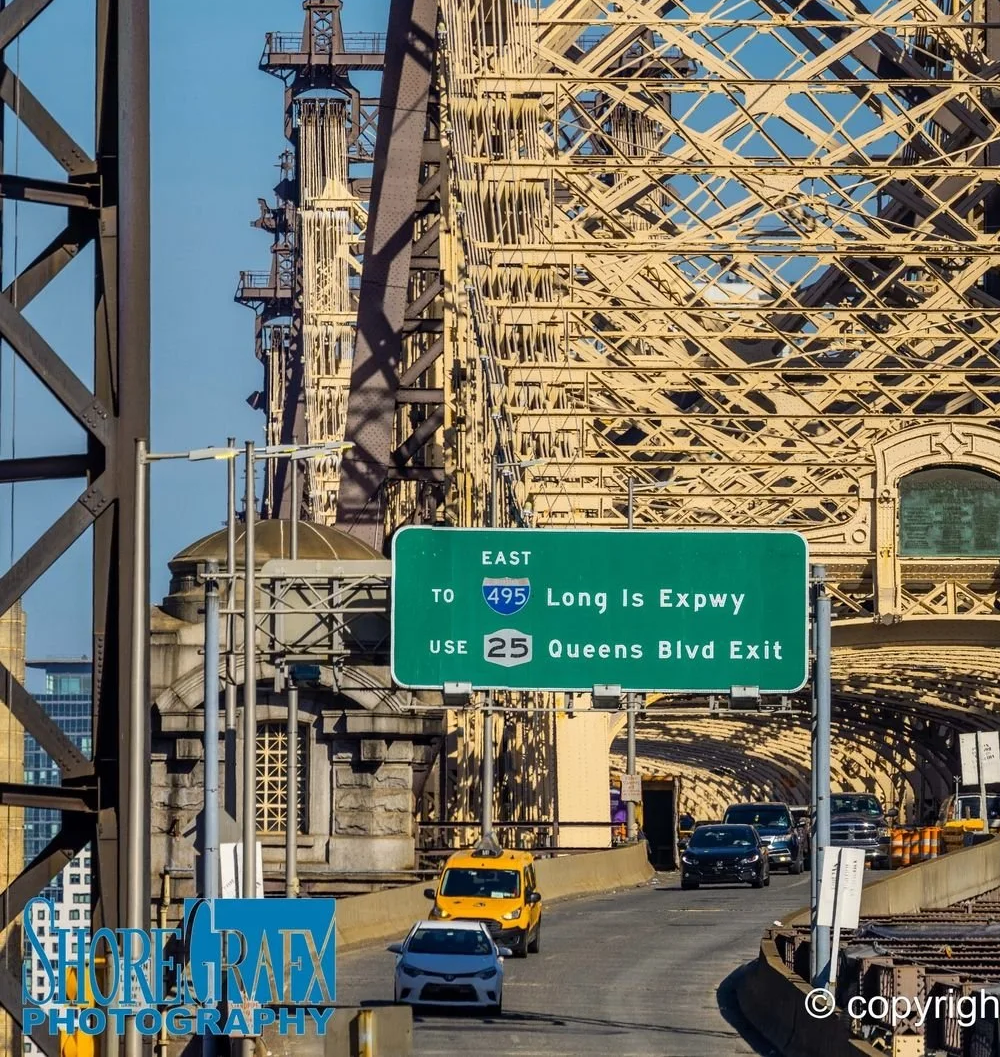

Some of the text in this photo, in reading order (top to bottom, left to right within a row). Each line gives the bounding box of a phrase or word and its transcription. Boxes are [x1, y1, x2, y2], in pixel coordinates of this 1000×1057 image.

[482, 550, 531, 565] EAST
[431, 587, 745, 616] TO 495 Long Is Expwy
[430, 637, 783, 661] USE 25 Queens Blvd Exit
